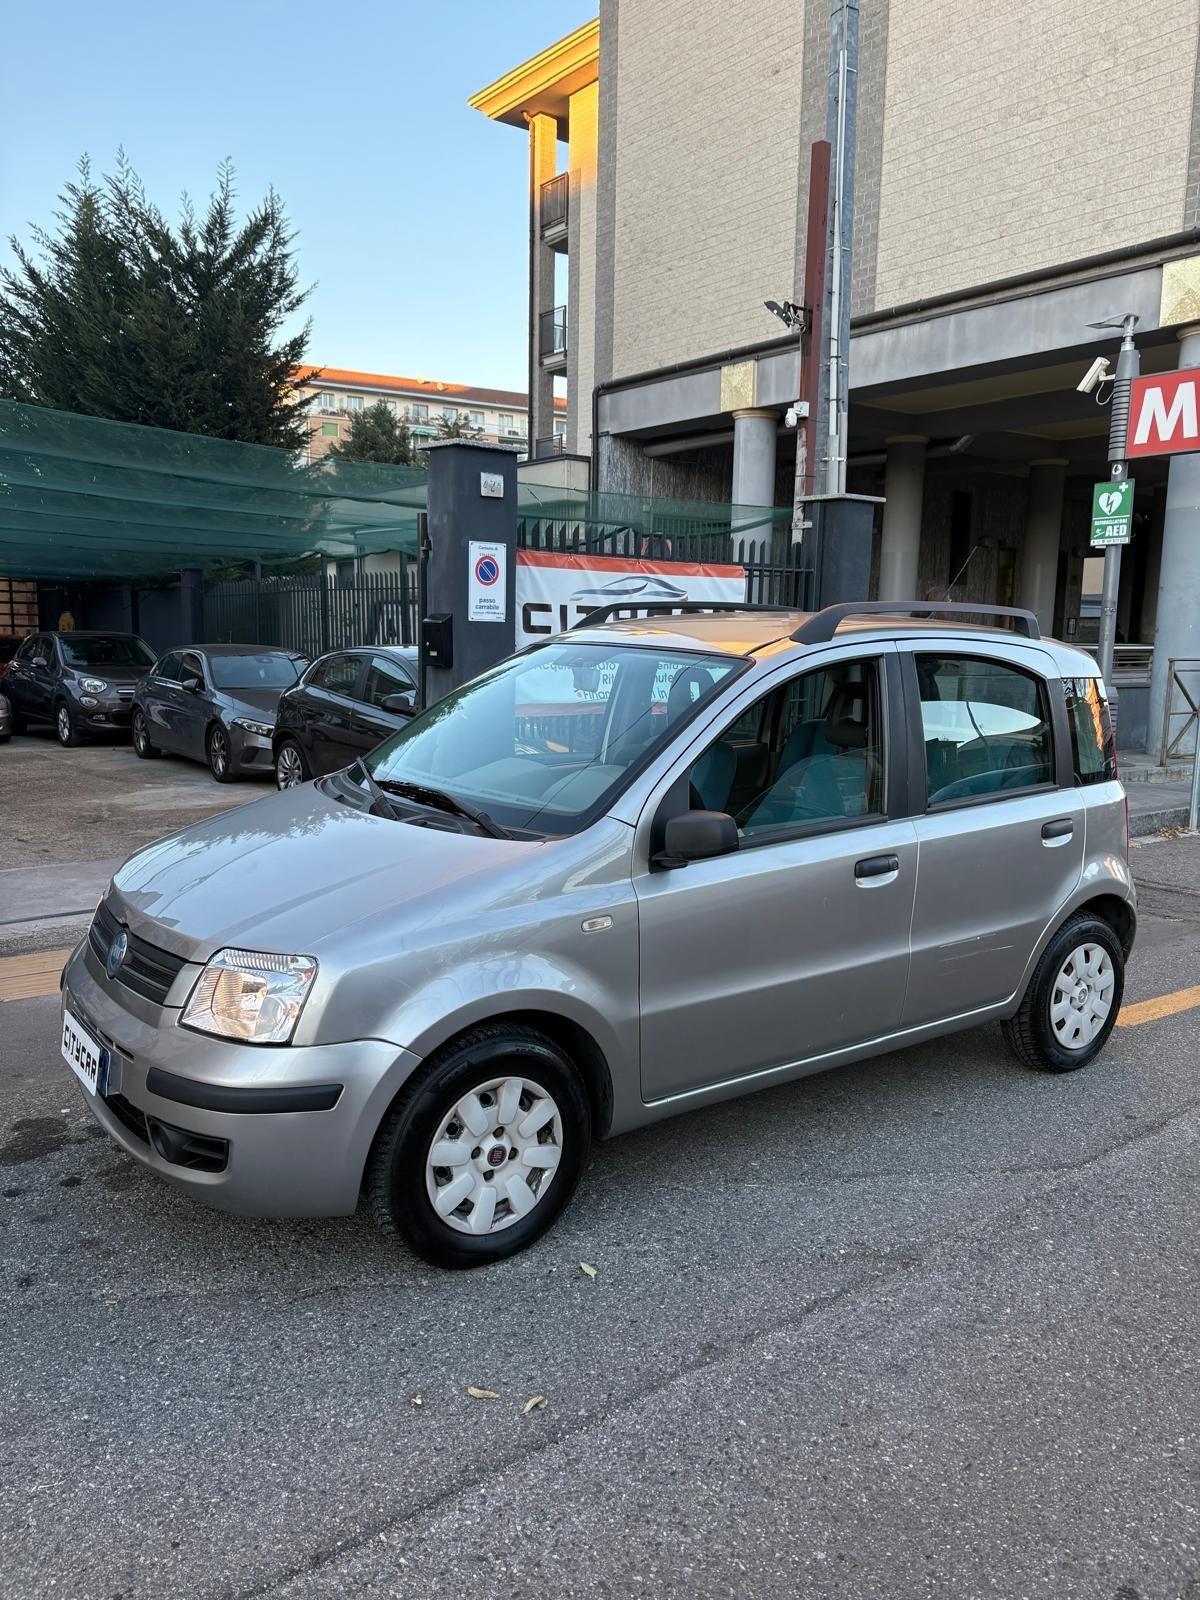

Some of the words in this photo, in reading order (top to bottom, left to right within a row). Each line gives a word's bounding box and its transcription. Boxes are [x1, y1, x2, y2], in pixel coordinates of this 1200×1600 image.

[1133, 381, 1198, 445] M
[1105, 524, 1127, 537] AED
[63, 1024, 97, 1084] CITYCAR
